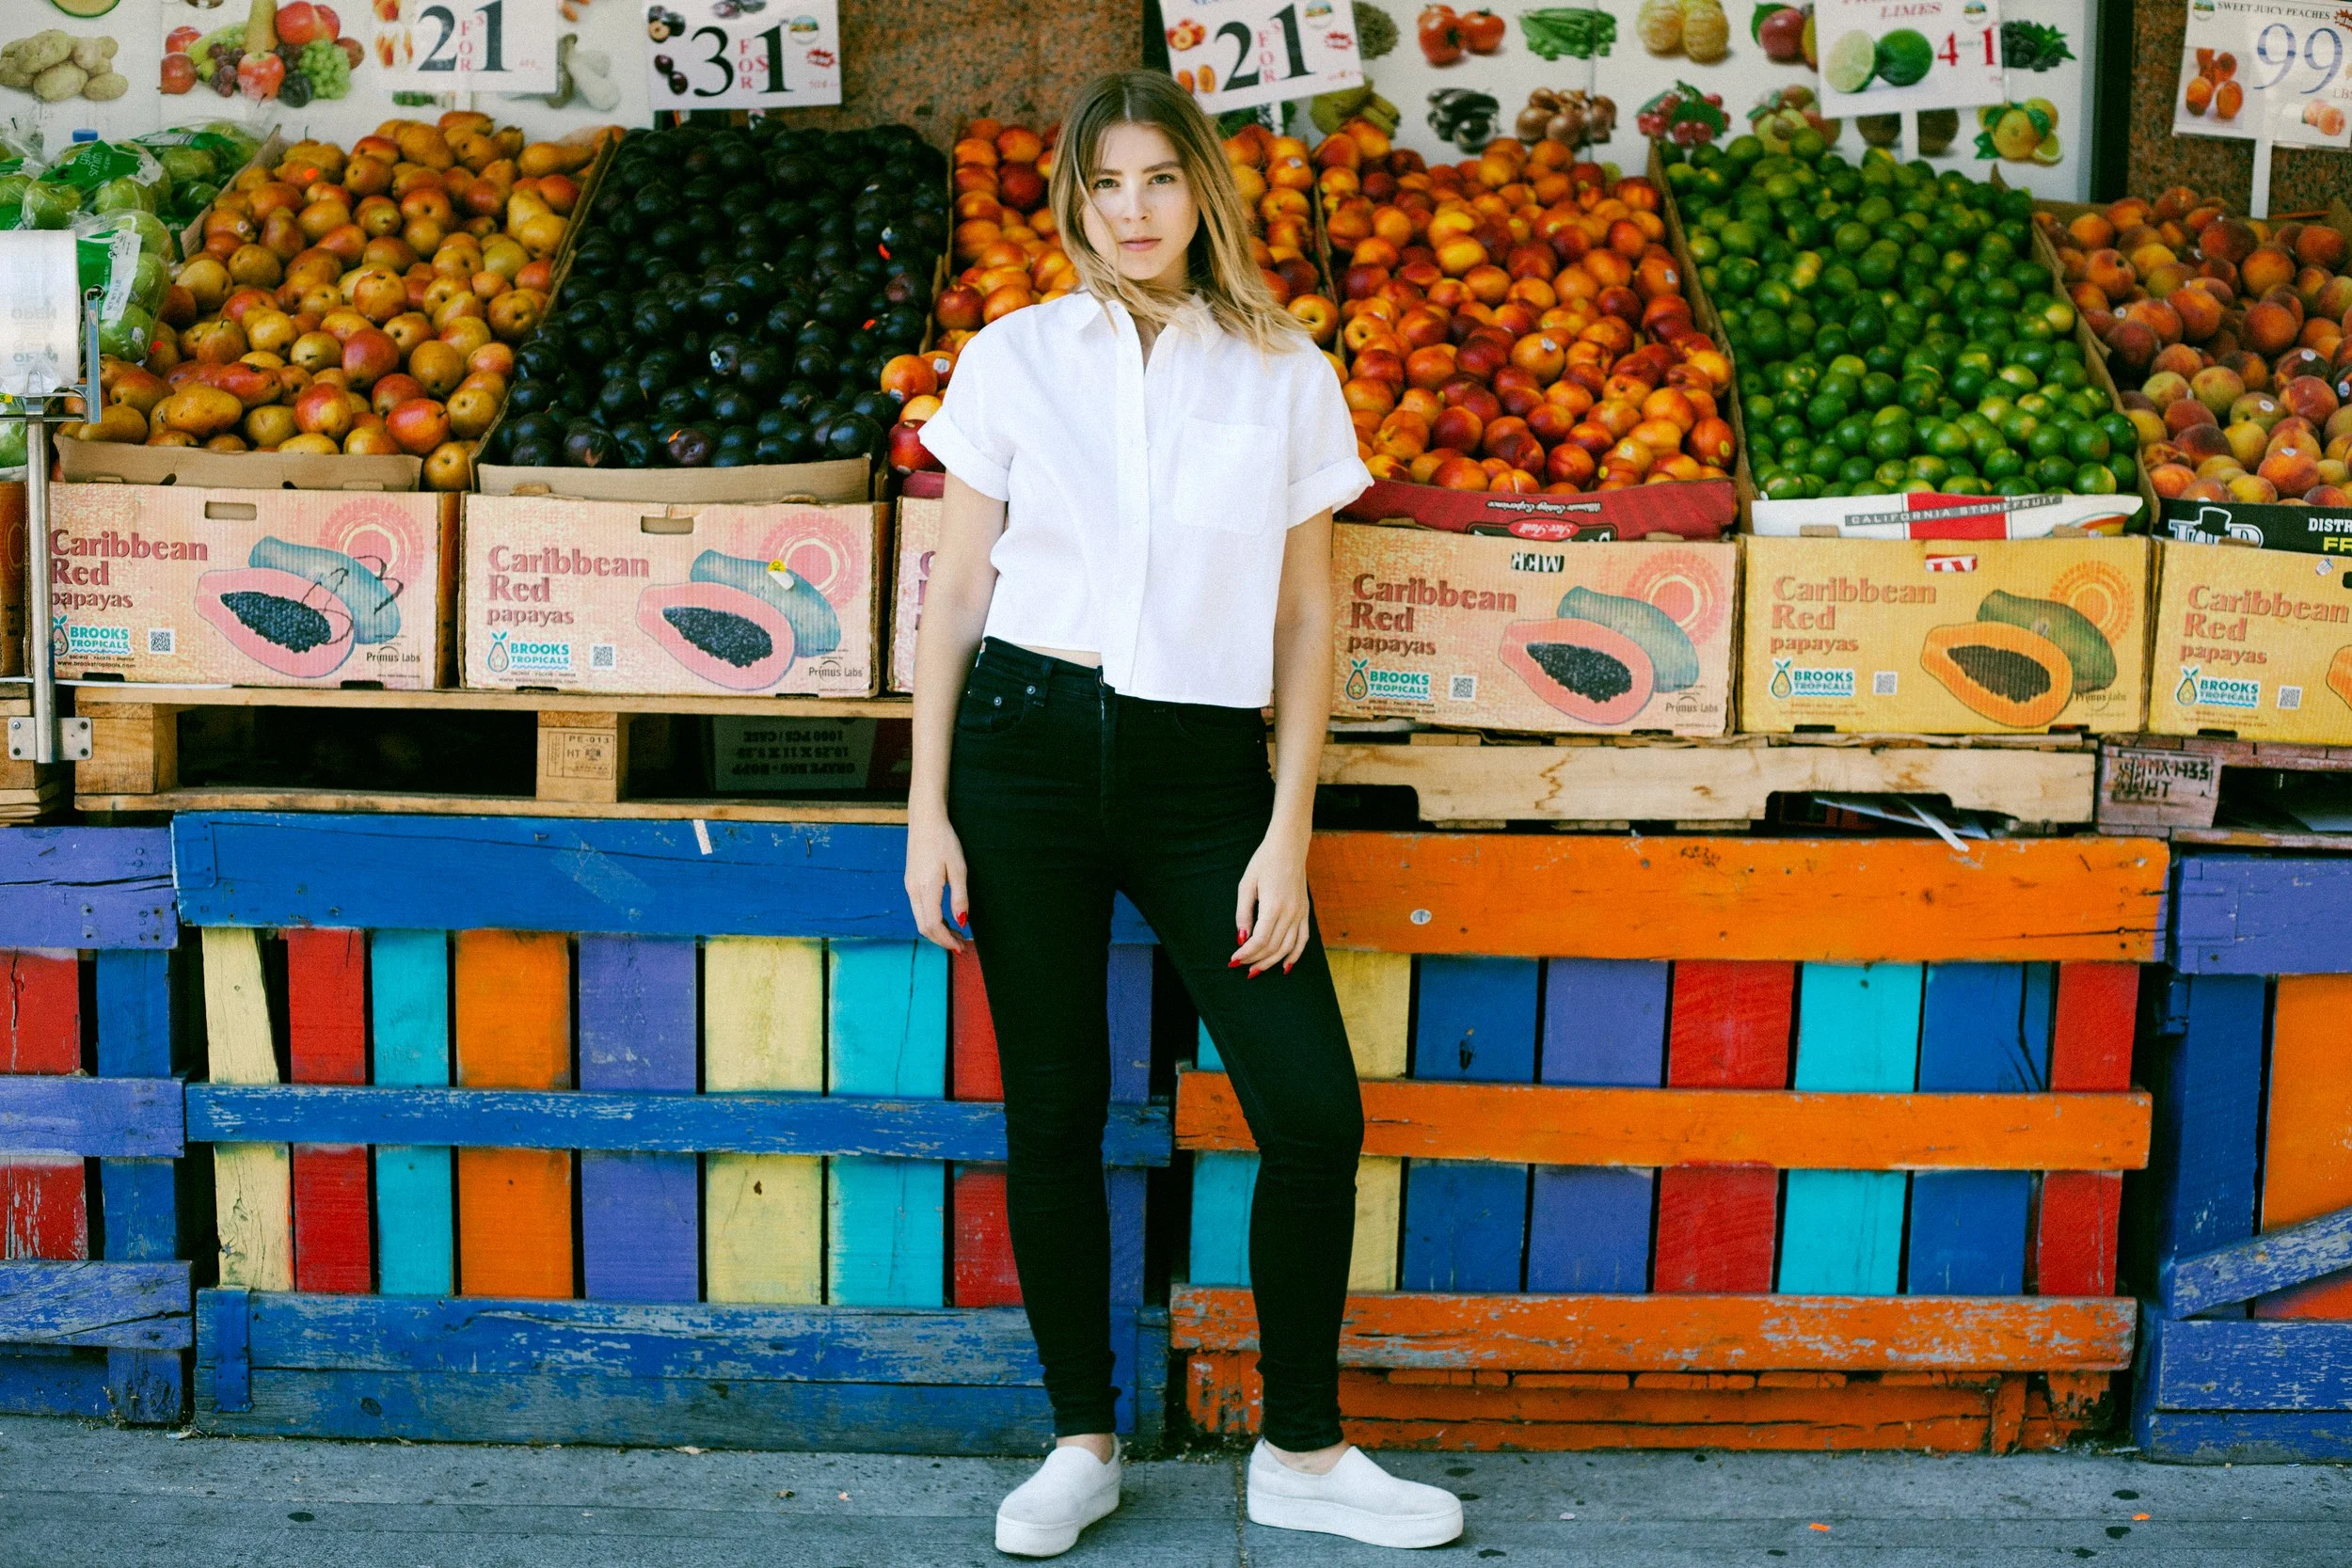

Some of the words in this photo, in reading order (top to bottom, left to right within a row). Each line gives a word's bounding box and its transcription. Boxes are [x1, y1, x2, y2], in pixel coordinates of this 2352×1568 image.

[2217, 1, 2251, 12] SWEET
[2253, 6, 2282, 15] JUICY
[2286, 8, 2330, 20] PEACHES
[418, 5, 457, 71] 2
[1937, 31, 1959, 67] 4
[1981, 26, 1996, 66] 1
[691, 25, 735, 97] 3
[738, 38, 754, 89] FOR
[1214, 21, 1261, 91] 2
[2252, 23, 2344, 95] 99
[1851, 508, 1951, 525] CALIFORNIA
[1960, 496, 2055, 516] STONEFRUIT
[51, 529, 208, 561] Caribbean
[52, 558, 109, 586] Red
[487, 545, 649, 578] Caribbean
[487, 574, 550, 603] Red
[1352, 573, 1517, 611] Caribbean
[1772, 576, 1937, 604] Caribbean
[2187, 583, 2349, 624] Caribbean
[486, 609, 575, 628] papayas
[1350, 601, 1416, 633] Red
[1771, 604, 1836, 630] Red
[2183, 612, 2248, 642] Red
[70, 626, 129, 640] BROOKS
[71, 639, 129, 649] TROPICALS
[511, 642, 569, 656] BROOKS
[1347, 635, 1437, 657] papayas
[1770, 637, 1860, 655] papayas
[2179, 644, 2267, 666] papayas
[366, 652, 400, 662] Primus
[402, 652, 421, 663] Labs
[511, 656, 569, 664] TROPICALS
[808, 666, 842, 677] Primus
[844, 666, 863, 677] Labs
[1369, 670, 1430, 686] BROOKS
[1794, 671, 1853, 682] BROOKS
[1369, 683, 1428, 694] TROPICALS
[1794, 682, 1852, 690] TROPICALS
[2200, 678, 2259, 694] BROOKS
[2200, 691, 2257, 703] TROPICALS
[1665, 702, 1698, 712] Primus
[1700, 703, 1719, 713] Labs
